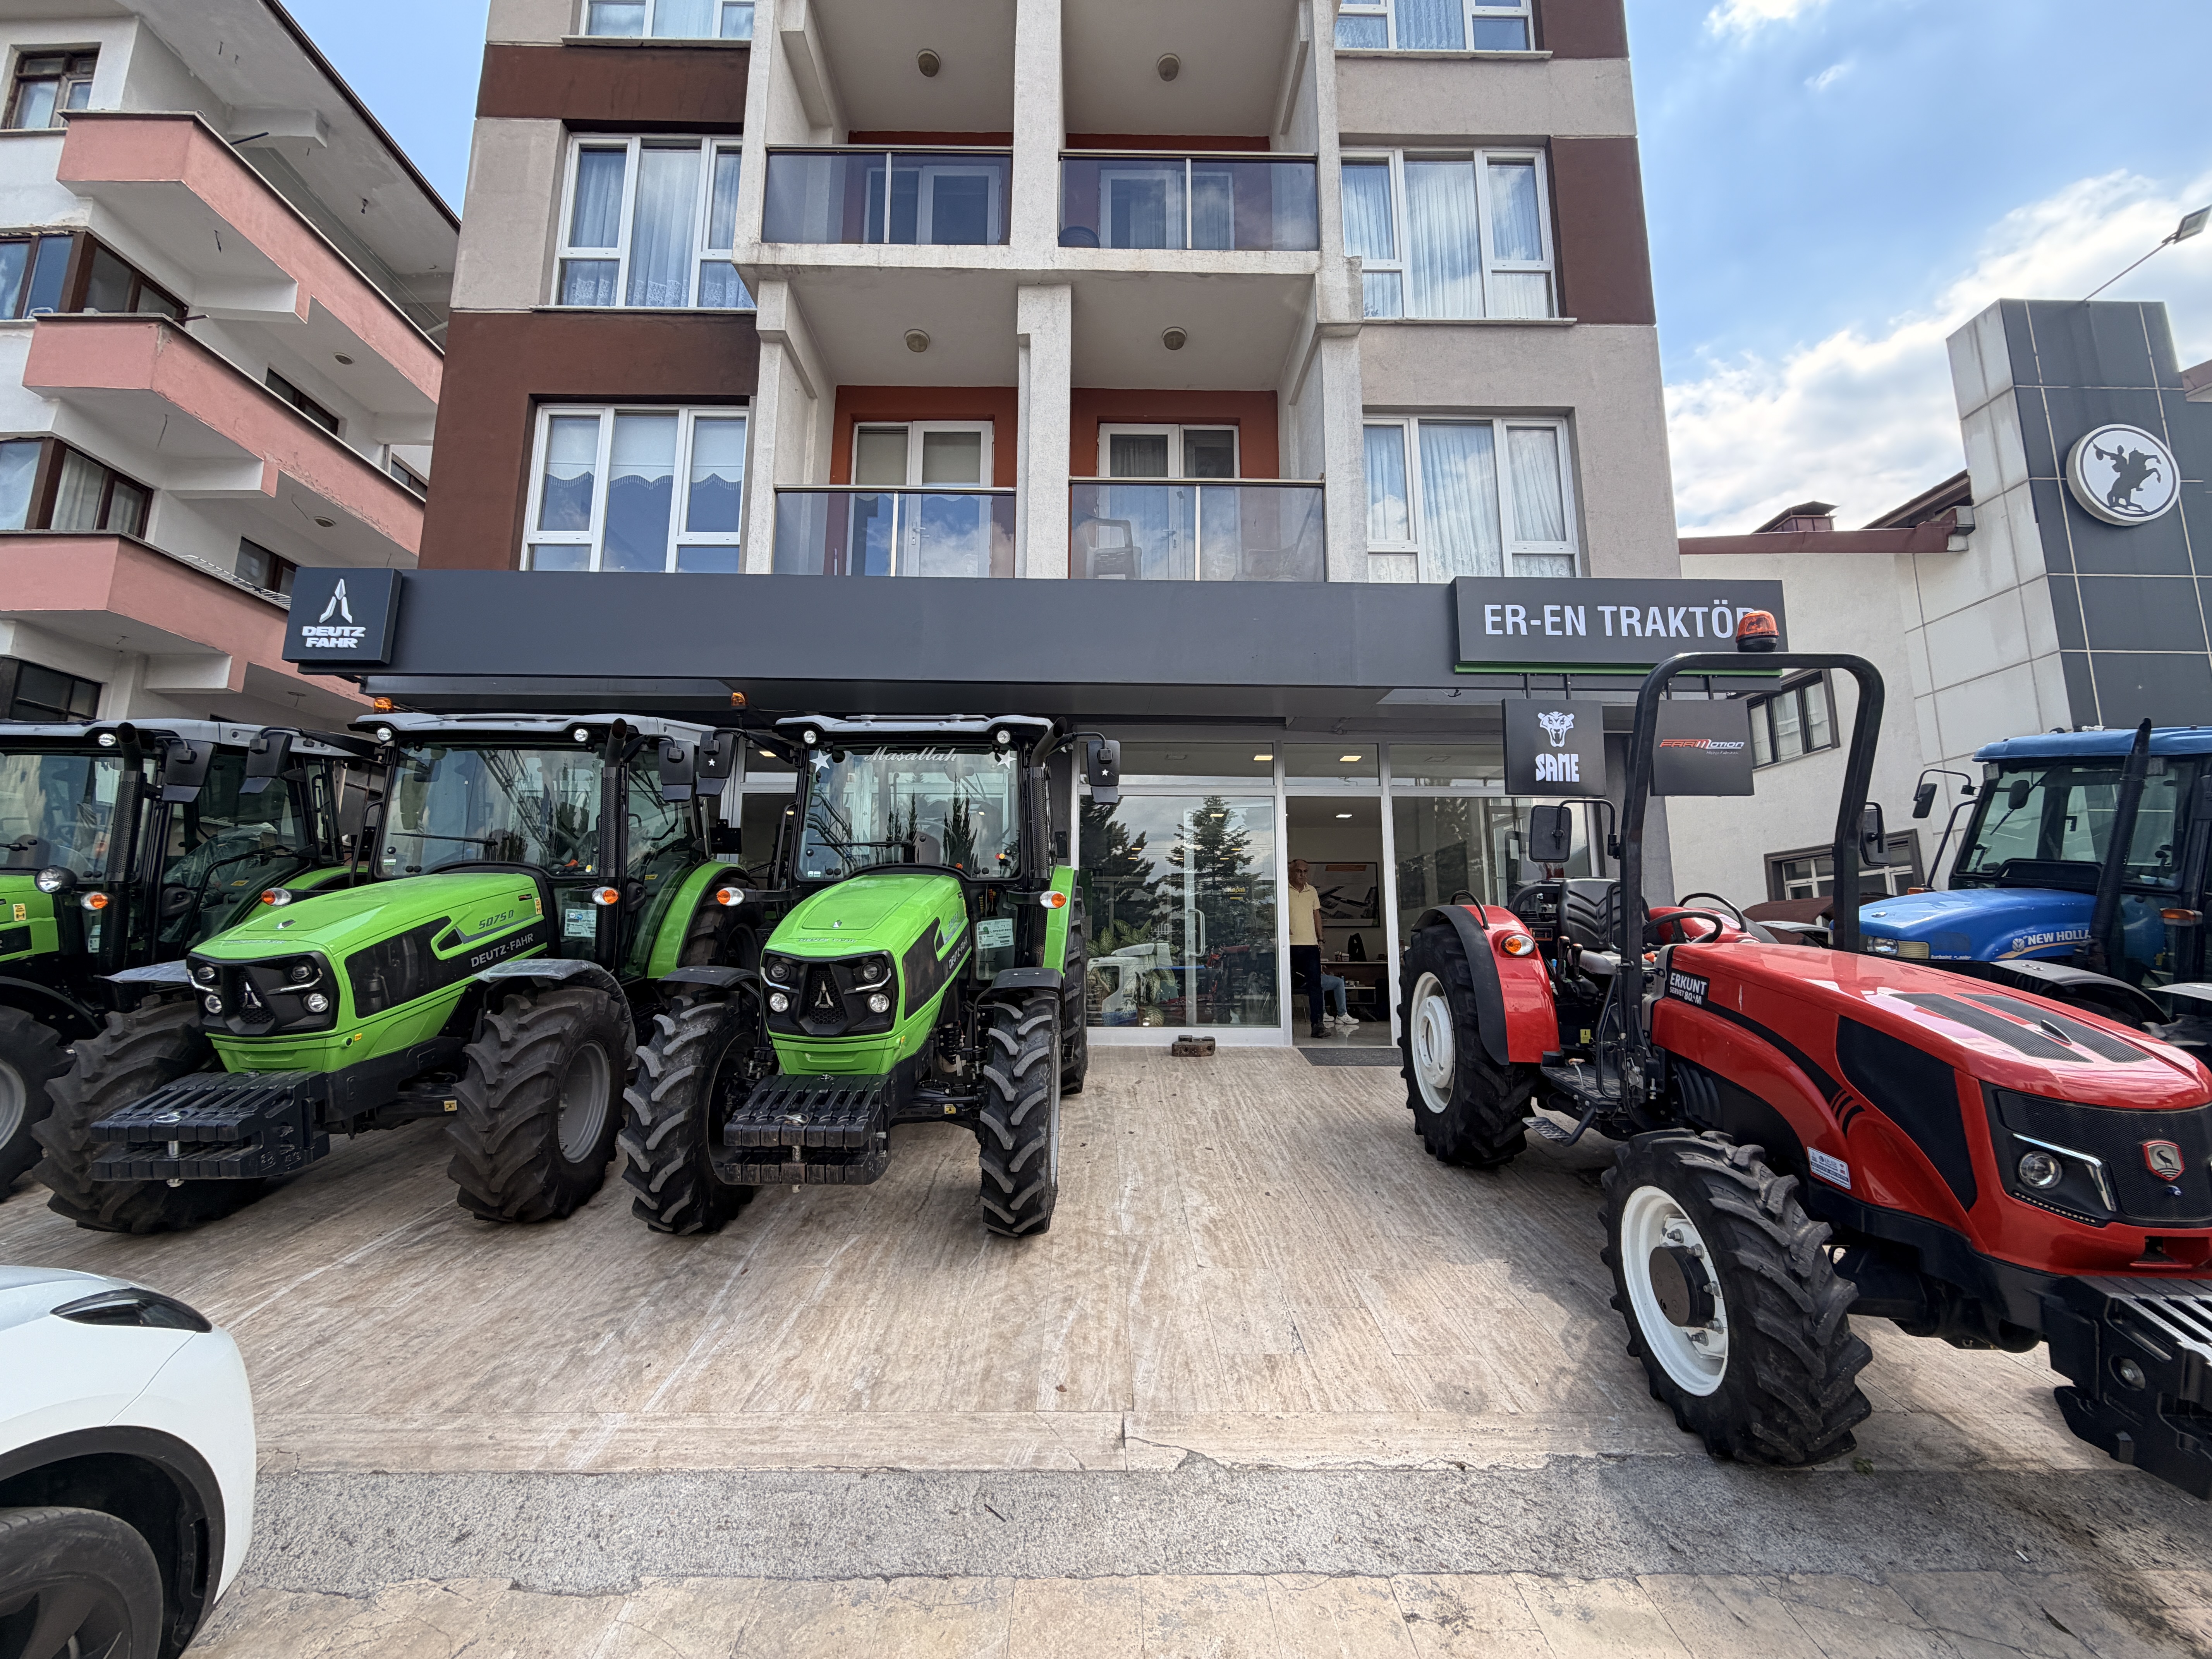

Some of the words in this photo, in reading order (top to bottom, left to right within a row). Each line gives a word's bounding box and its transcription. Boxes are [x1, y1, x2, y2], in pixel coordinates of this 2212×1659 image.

[1484, 604, 1587, 636] ER-EN
[302, 626, 366, 637] DEUTZ
[306, 637, 358, 648] FAHR
[1535, 753, 1580, 782] SAME
[2023, 932, 2054, 945] NEW
[2056, 929, 2091, 941] HOLLA
[471, 933, 534, 968] DEUTZ-FAHR
[1669, 986, 1685, 997] SERVET
[1670, 972, 1707, 995] ERKUNT
